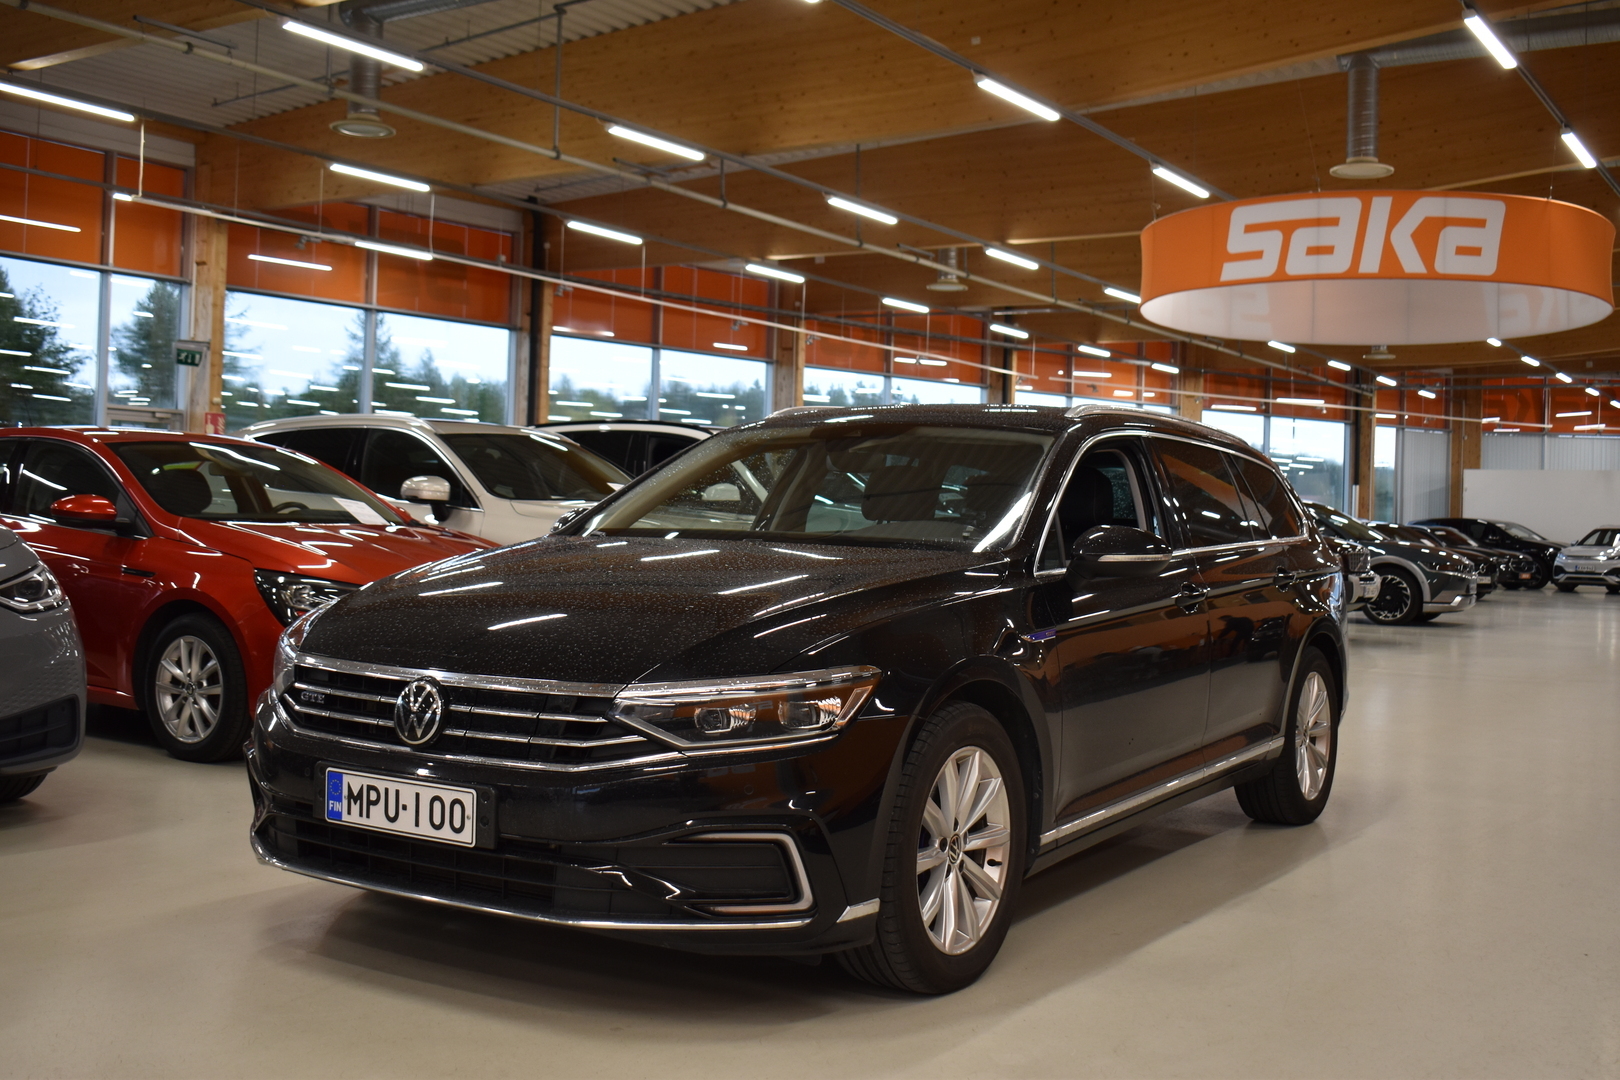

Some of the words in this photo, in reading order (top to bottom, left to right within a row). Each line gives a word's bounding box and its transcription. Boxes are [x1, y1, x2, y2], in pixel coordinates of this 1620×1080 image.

[300, 691, 325, 705] GTE
[328, 800, 342, 813] FIN
[346, 781, 466, 834] MPU-100
